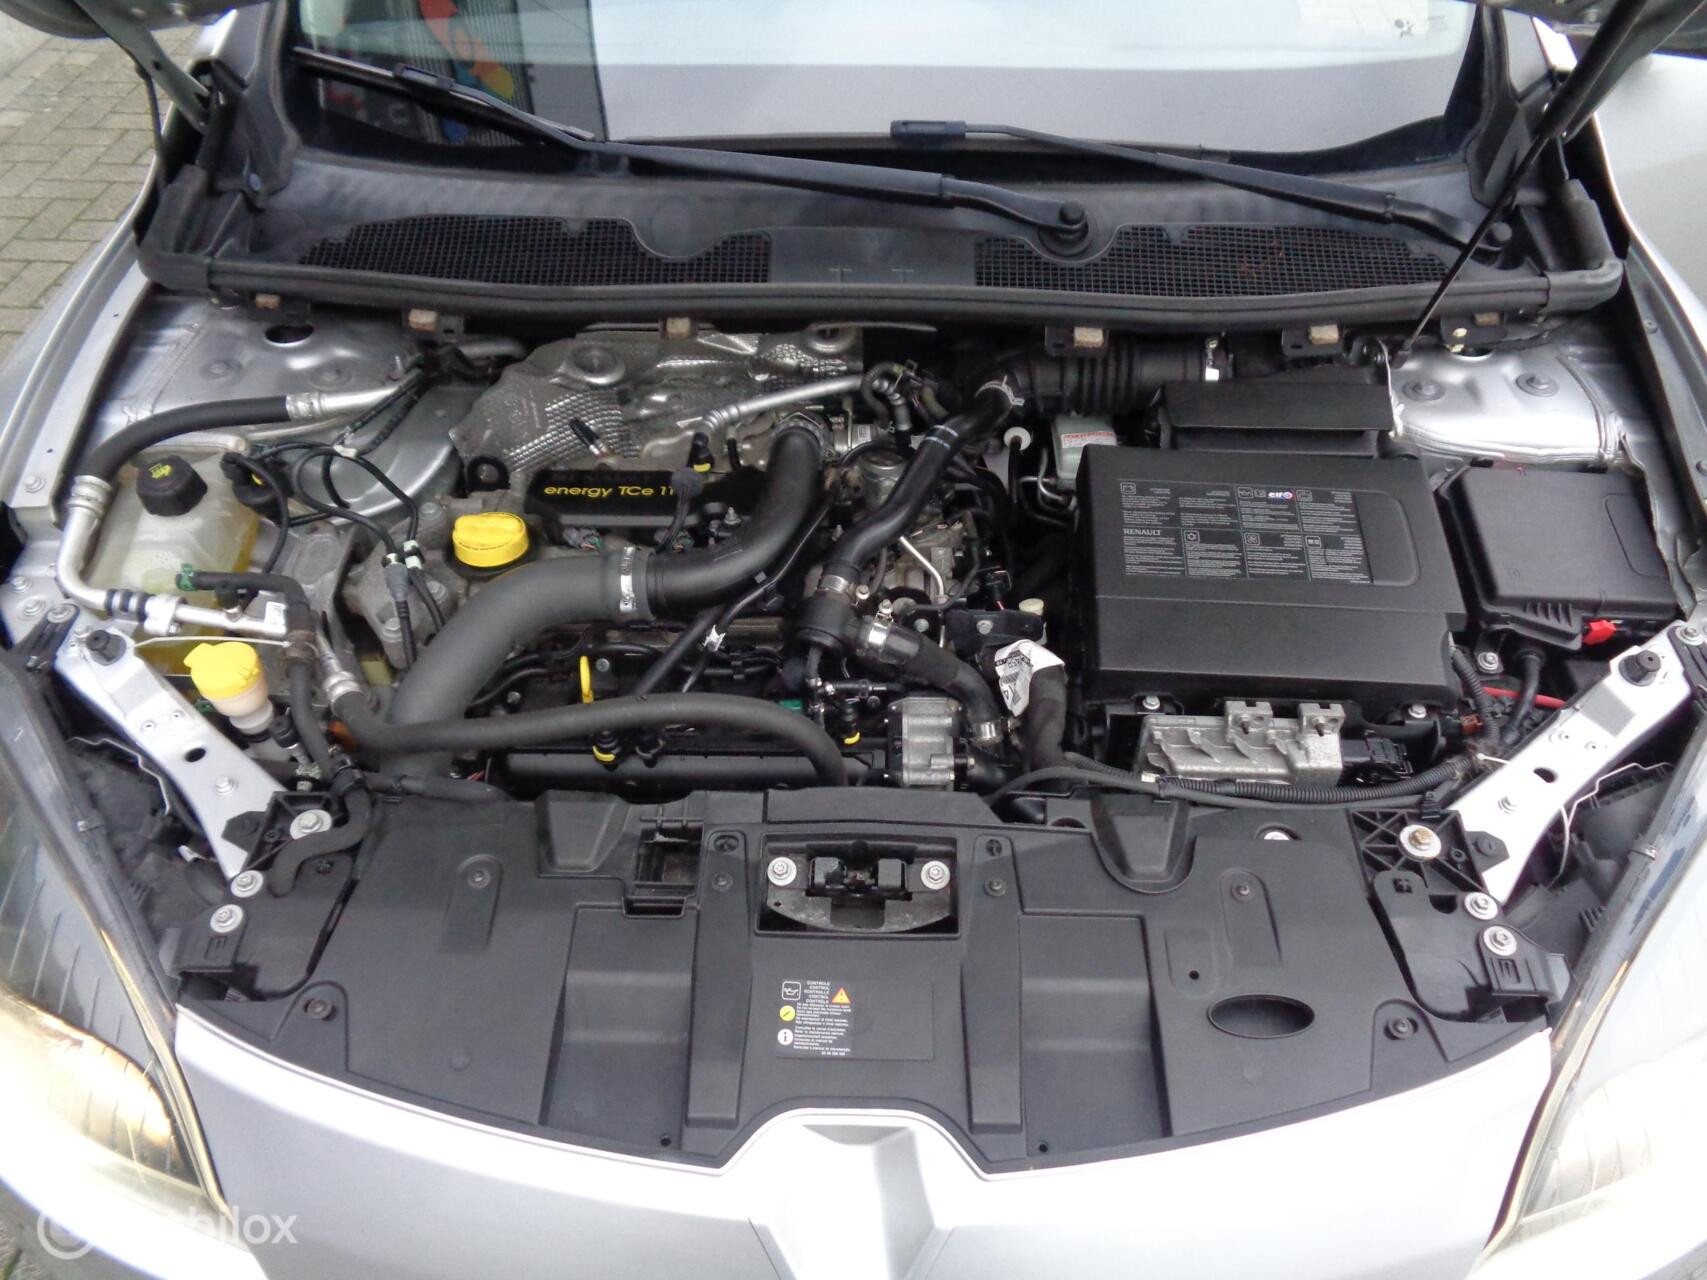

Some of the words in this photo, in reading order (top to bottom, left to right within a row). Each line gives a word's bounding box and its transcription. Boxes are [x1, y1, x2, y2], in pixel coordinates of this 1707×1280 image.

[543, 486, 612, 498] energy
[618, 486, 654, 496] TCe
[659, 486, 675, 496] 11
[1123, 528, 1161, 536] RENAULT
